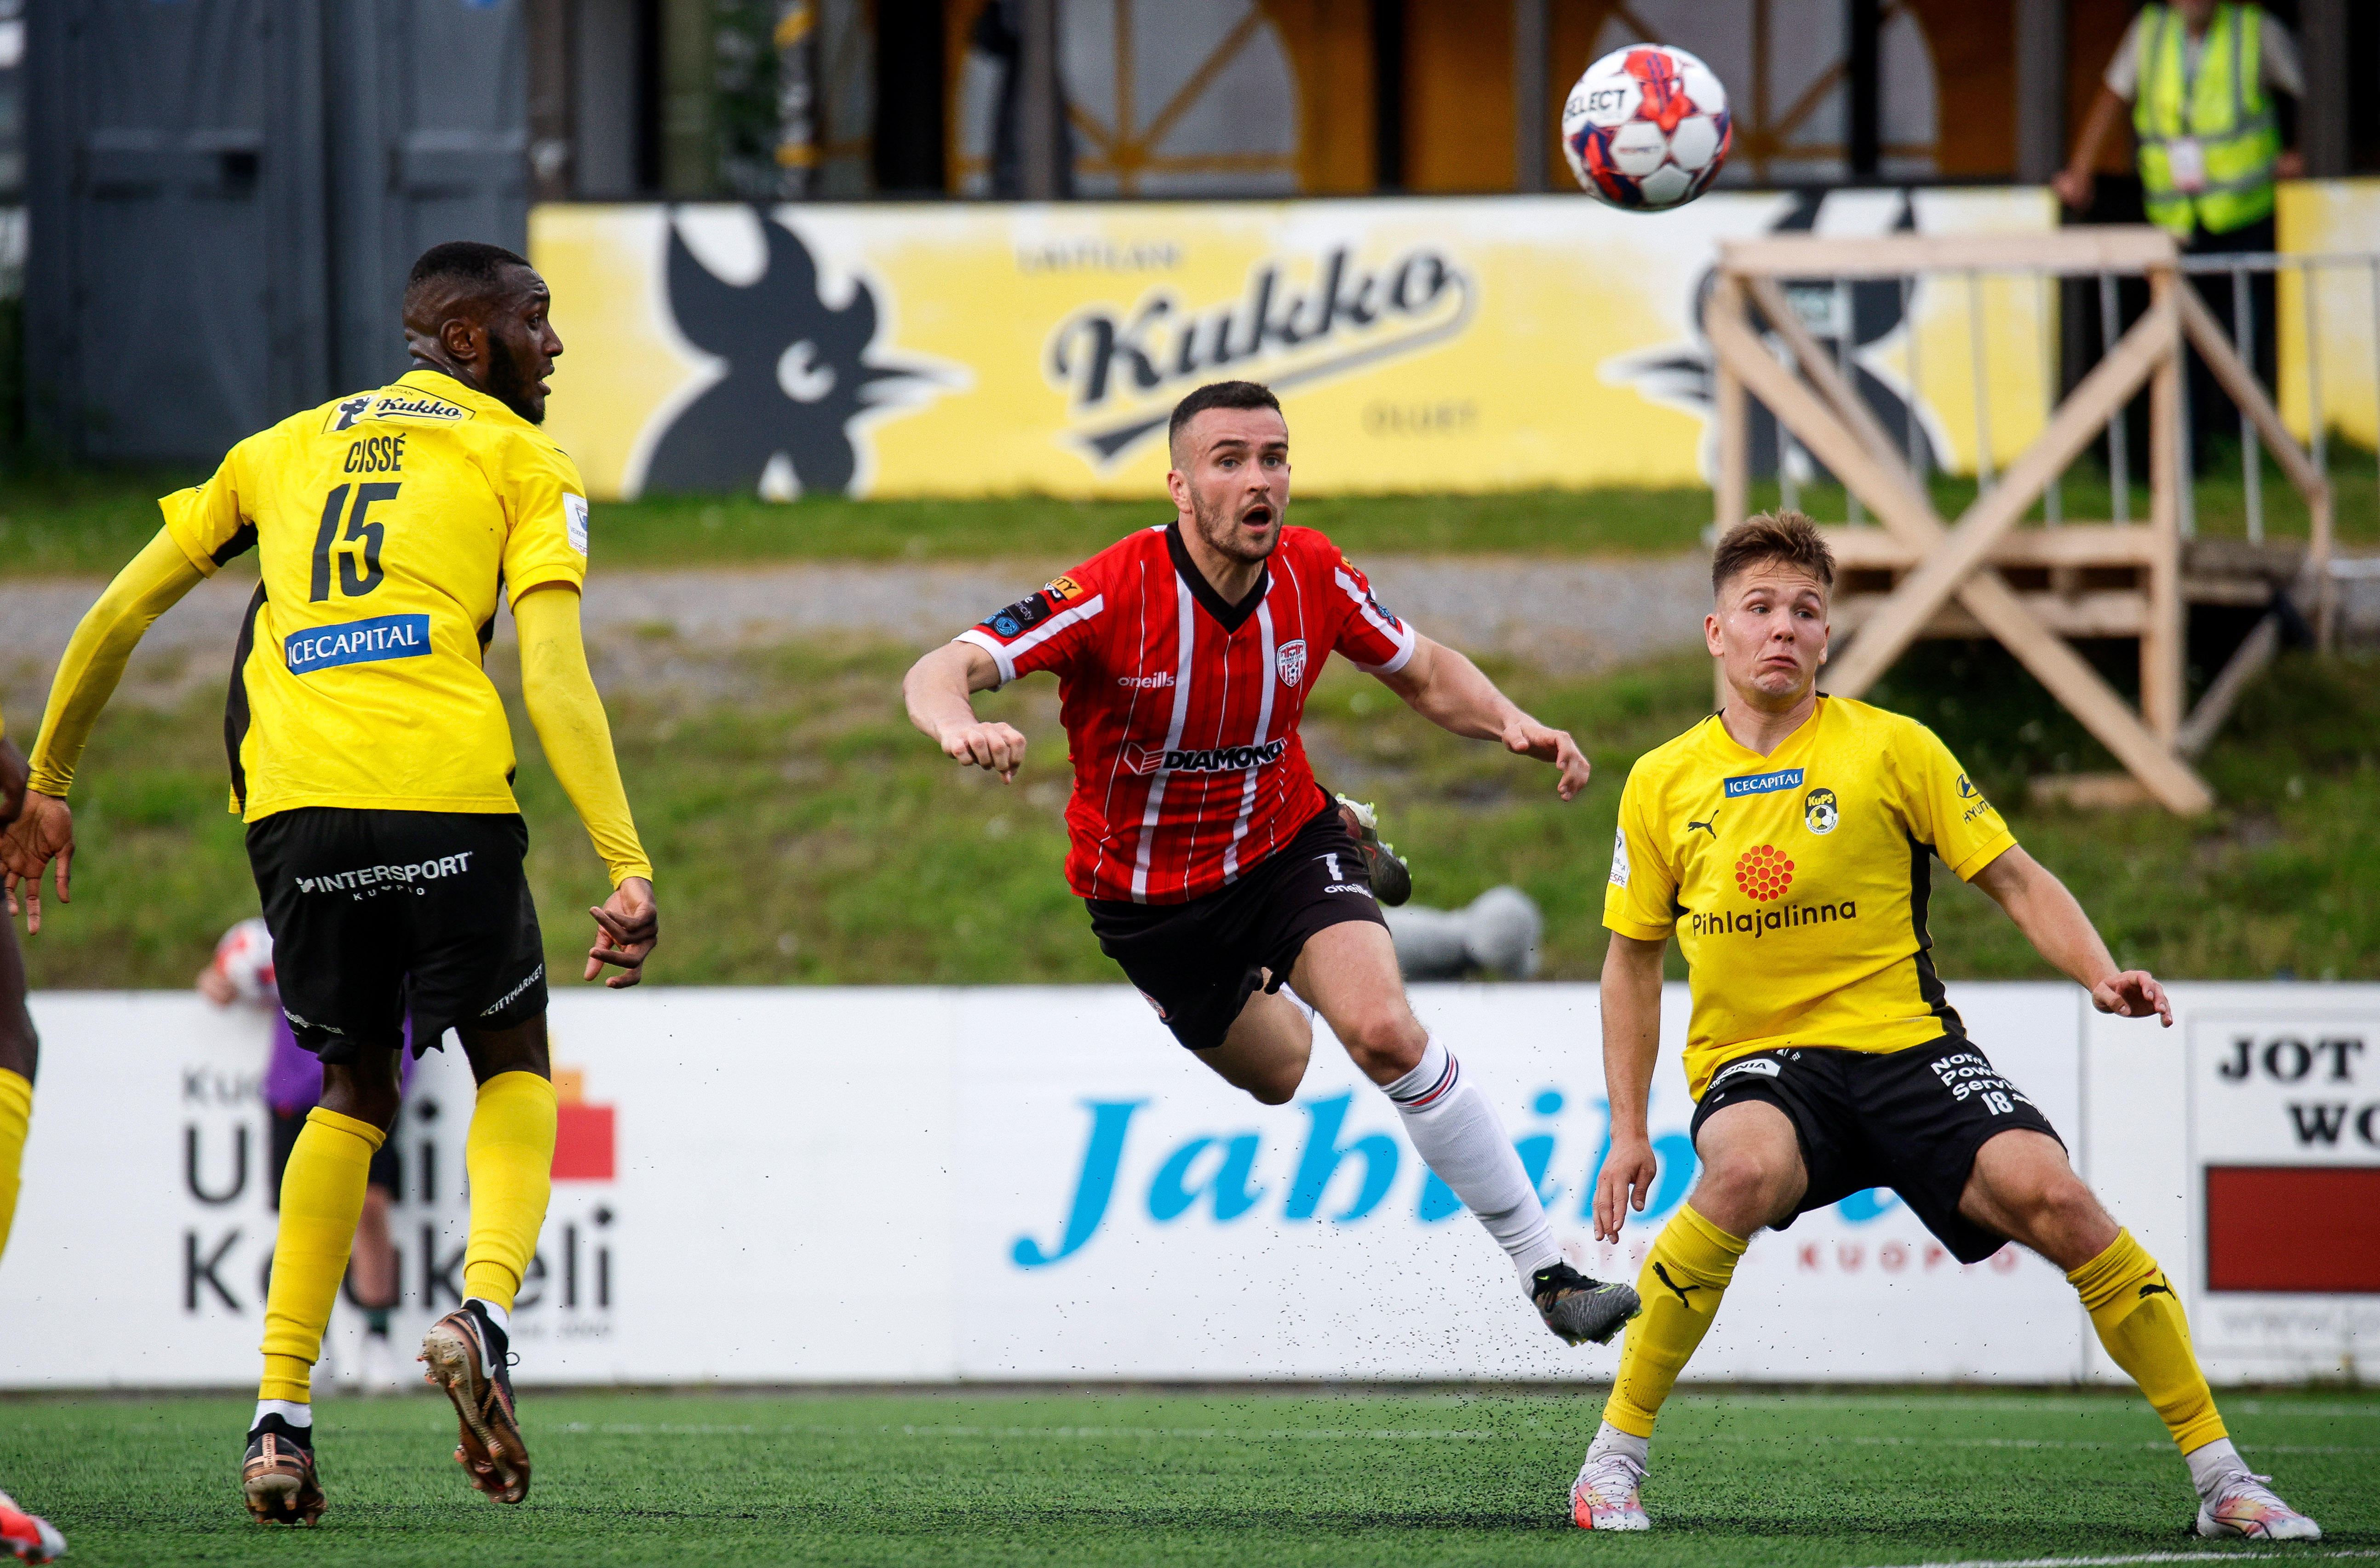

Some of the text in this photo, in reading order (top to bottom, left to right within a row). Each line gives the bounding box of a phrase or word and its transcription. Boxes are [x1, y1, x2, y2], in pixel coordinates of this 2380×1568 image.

[1053, 246, 1456, 405] Kukko
[376, 397, 461, 418] Kukko
[344, 431, 407, 473] CISSÉ
[309, 482, 402, 603] 15
[287, 624, 420, 667] ICECAPITAL
[1163, 739, 1285, 771] DIAMOND
[1729, 772, 1801, 793] ICECAPITAL
[1808, 793, 1834, 807] KuPS
[315, 851, 469, 893] INTERSPORT
[1692, 901, 1857, 939] Pihlajalinna
[2220, 1036, 2364, 1082] JOT
[1980, 1090, 2014, 1116] 18
[1796, 1240, 2021, 1274] KUOPO
